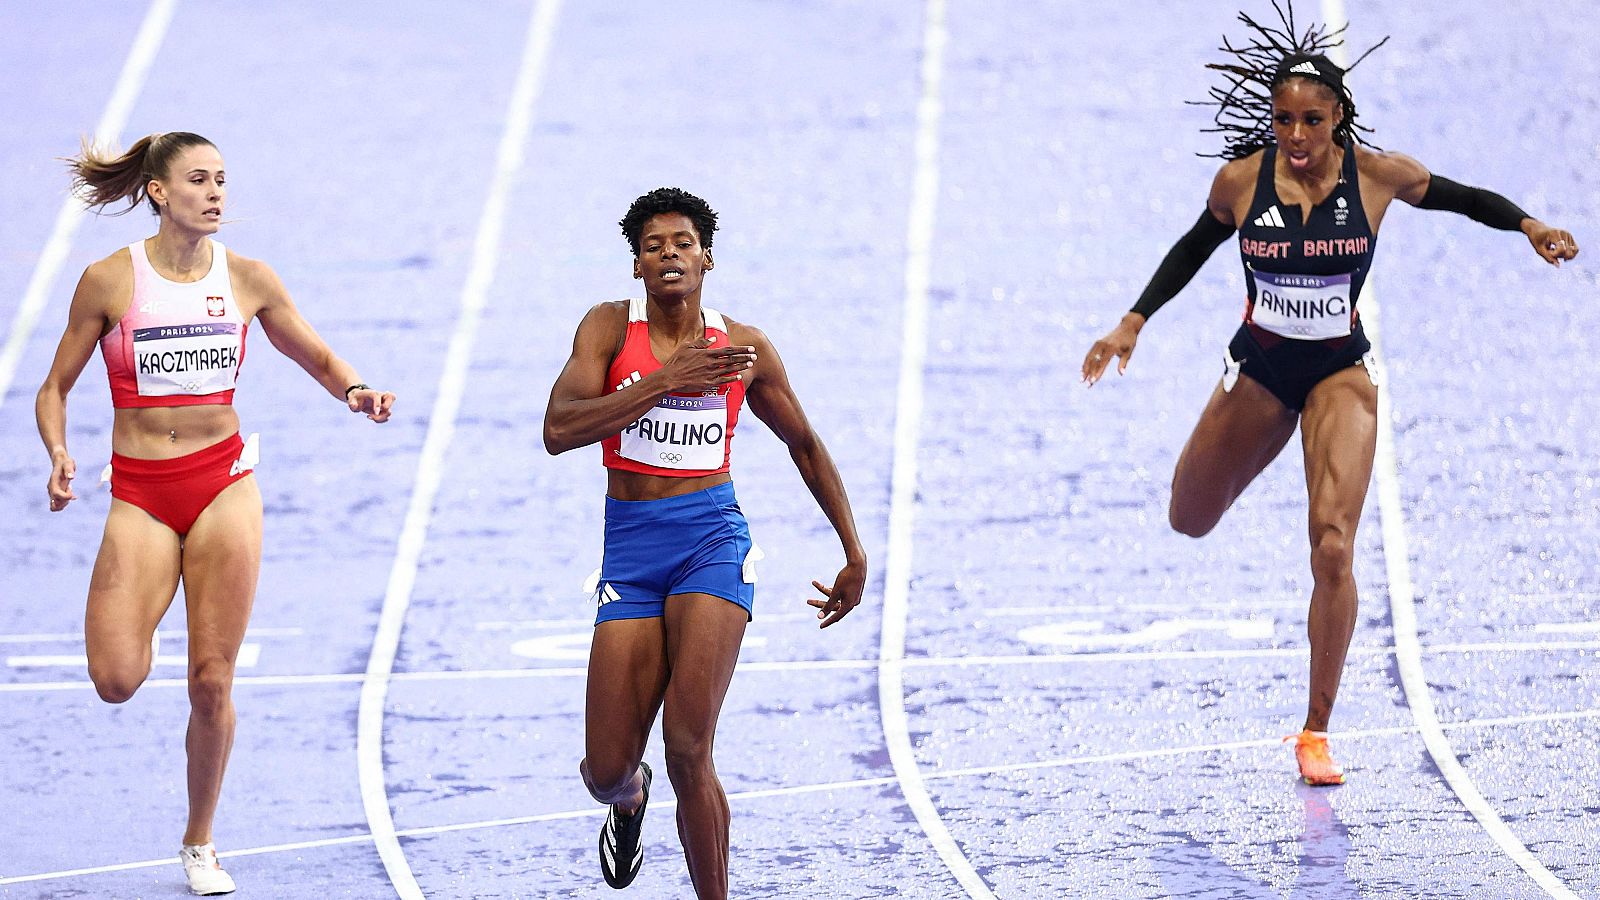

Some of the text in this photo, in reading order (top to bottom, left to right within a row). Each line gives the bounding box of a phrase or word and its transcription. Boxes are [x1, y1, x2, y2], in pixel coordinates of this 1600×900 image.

[1241, 236, 1369, 259] GREAT BRITAIN
[1261, 289, 1346, 320] ANNING
[161, 326, 213, 337] PARIS 2024
[139, 346, 238, 375] KACZMAREK
[658, 398, 704, 408] RIS 2024
